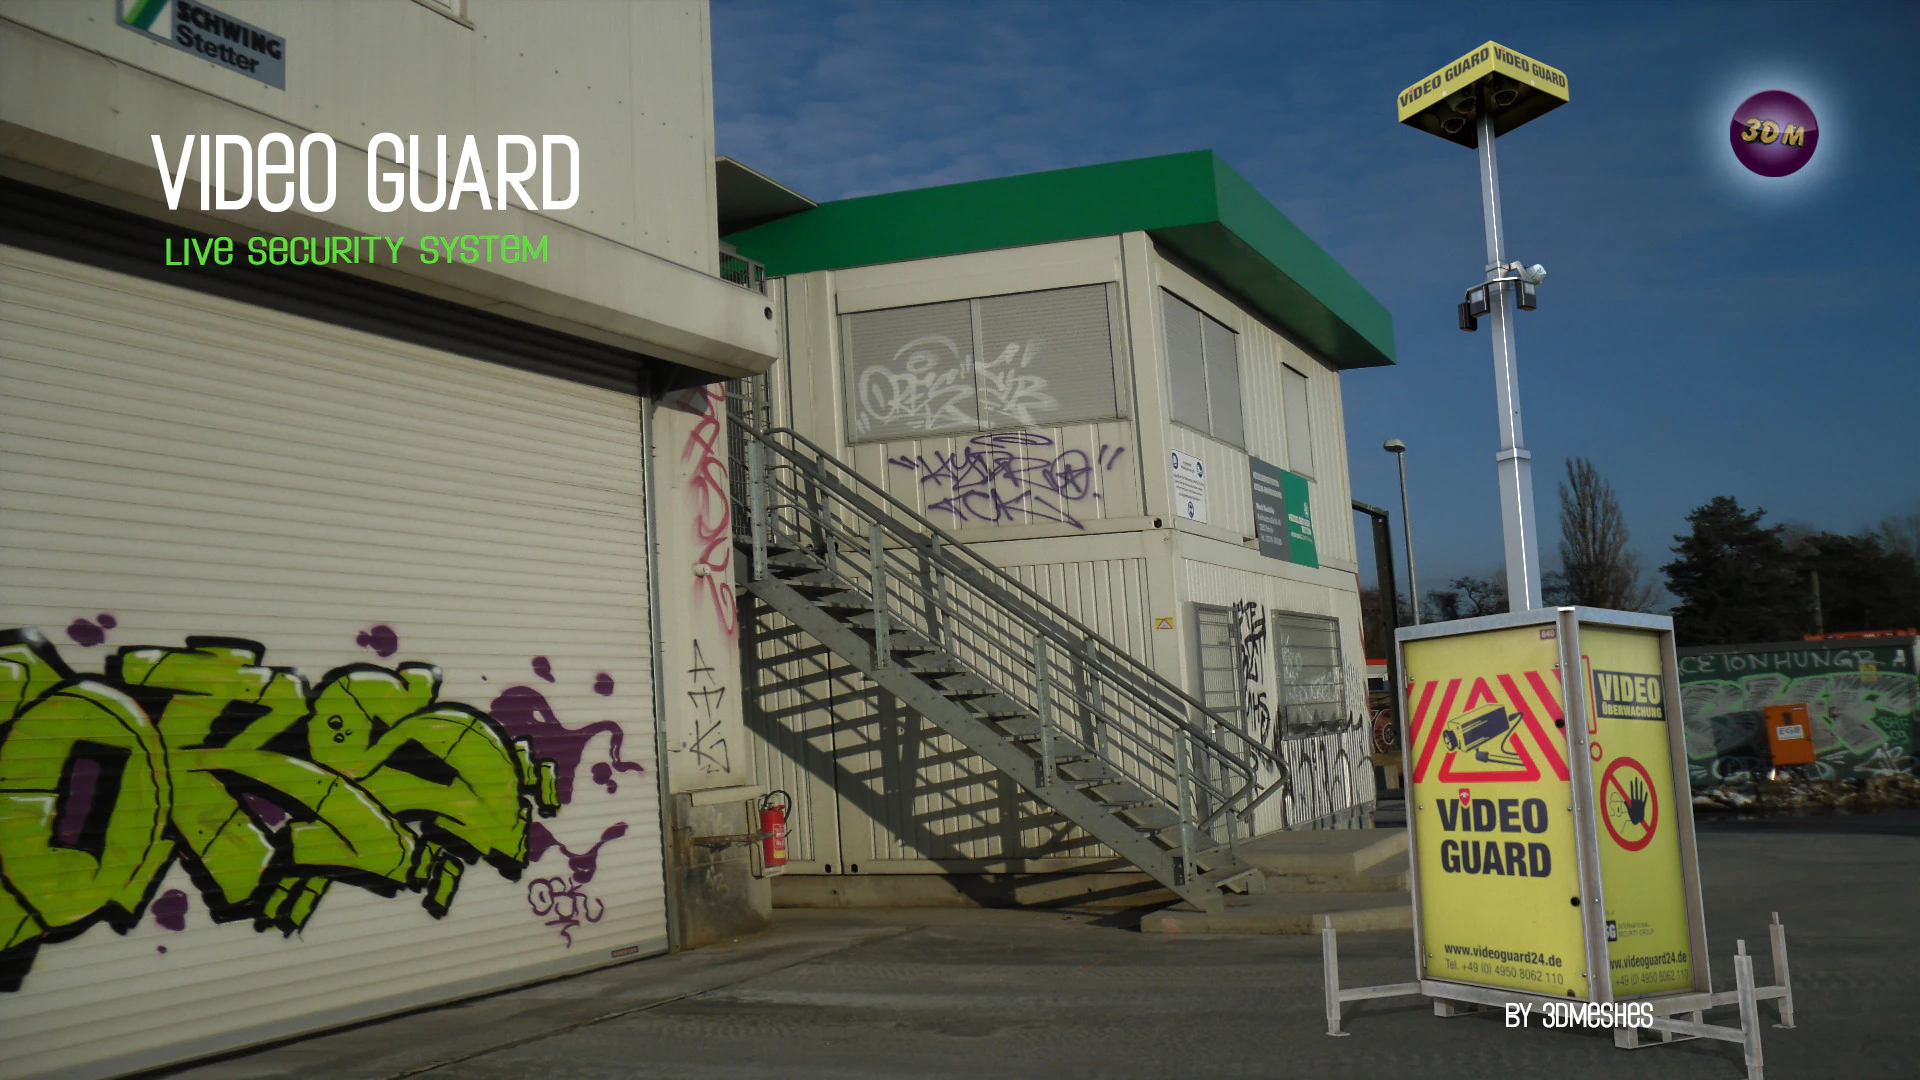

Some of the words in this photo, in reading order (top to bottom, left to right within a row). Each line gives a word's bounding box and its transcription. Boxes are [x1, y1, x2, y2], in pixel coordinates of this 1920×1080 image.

[177, 0, 282, 59] SCHWING
[176, 24, 259, 73] Stetter
[1445, 47, 1489, 82] GUARD
[1532, 63, 1566, 88] GUARD
[1597, 673, 1661, 705] VIDEO
[1602, 701, 1663, 718] ÜBERWACHUNG
[1440, 839, 1552, 878] GUARD
[1444, 943, 1563, 968] www.videoguard24.de
[1463, 962, 1479, 973] +49
[1481, 963, 1492, 975] (0)
[1495, 964, 1517, 979] 4950
[1520, 967, 1543, 983] 8062
[1546, 972, 1564, 986] 110
